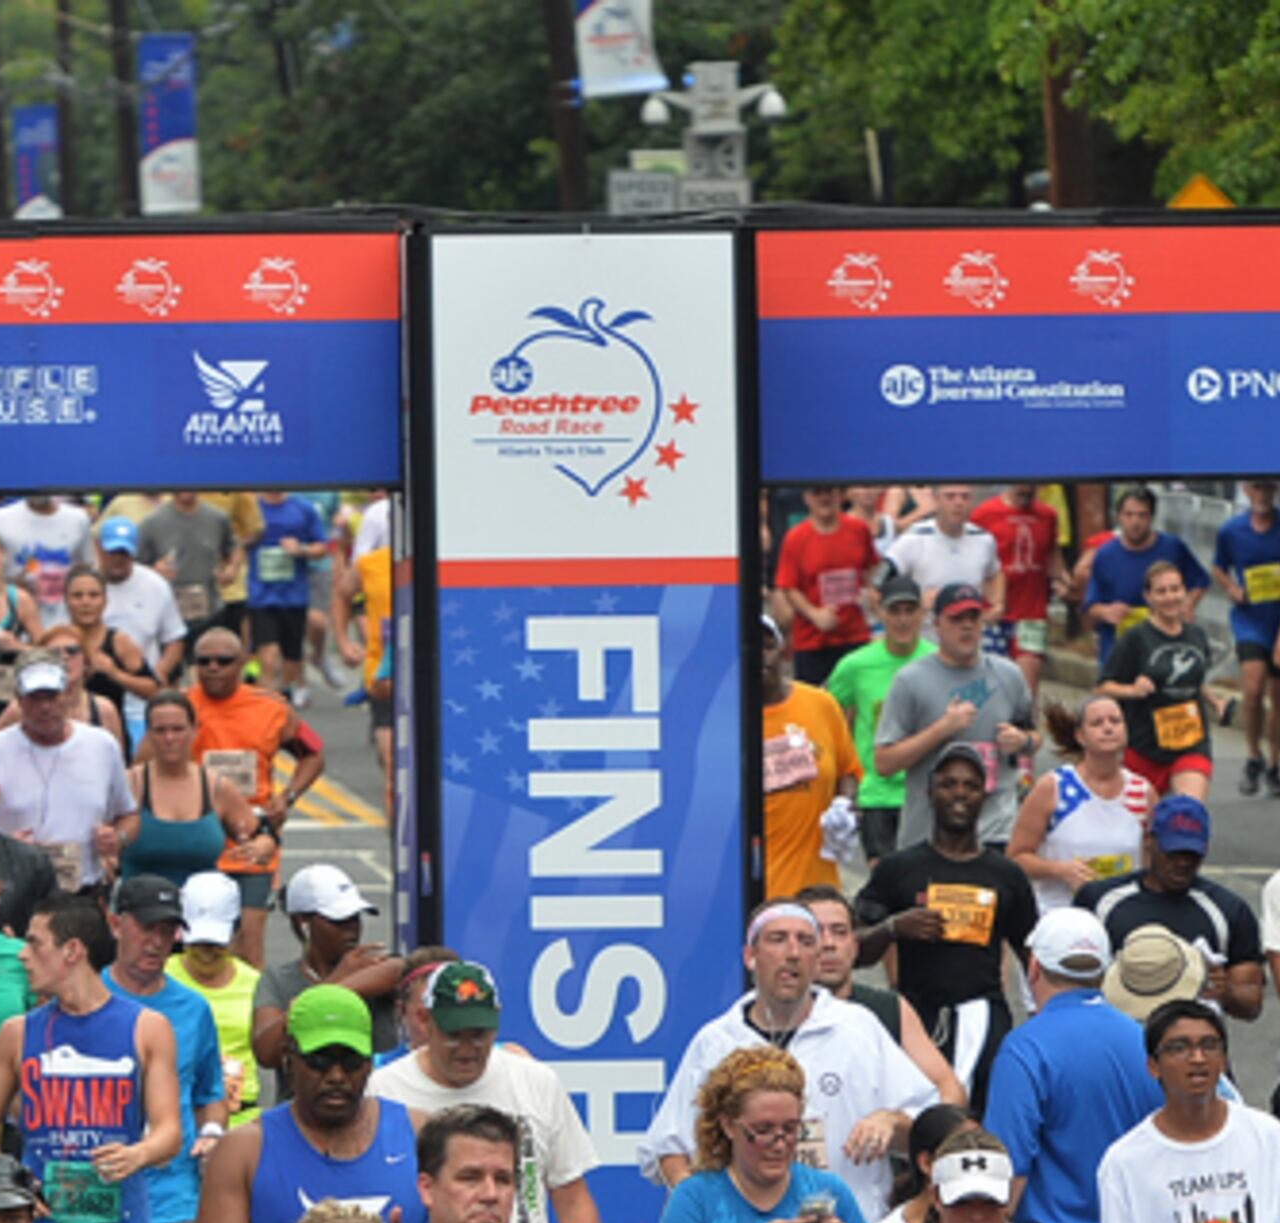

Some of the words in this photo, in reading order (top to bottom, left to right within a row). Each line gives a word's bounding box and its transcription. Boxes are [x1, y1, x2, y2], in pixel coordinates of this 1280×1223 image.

[928, 366, 962, 383] The
[966, 365, 1036, 383] Atlanta
[468, 393, 641, 417] Peachtree
[184, 412, 282, 434] ATLANTA
[498, 418, 550, 434] Road
[556, 418, 605, 434] Race
[524, 614, 668, 1168] FINISH
[22, 1058, 134, 1130] SWAMP
[1169, 1175, 1216, 1200] TEAM
[1217, 1171, 1249, 1192] UPS
